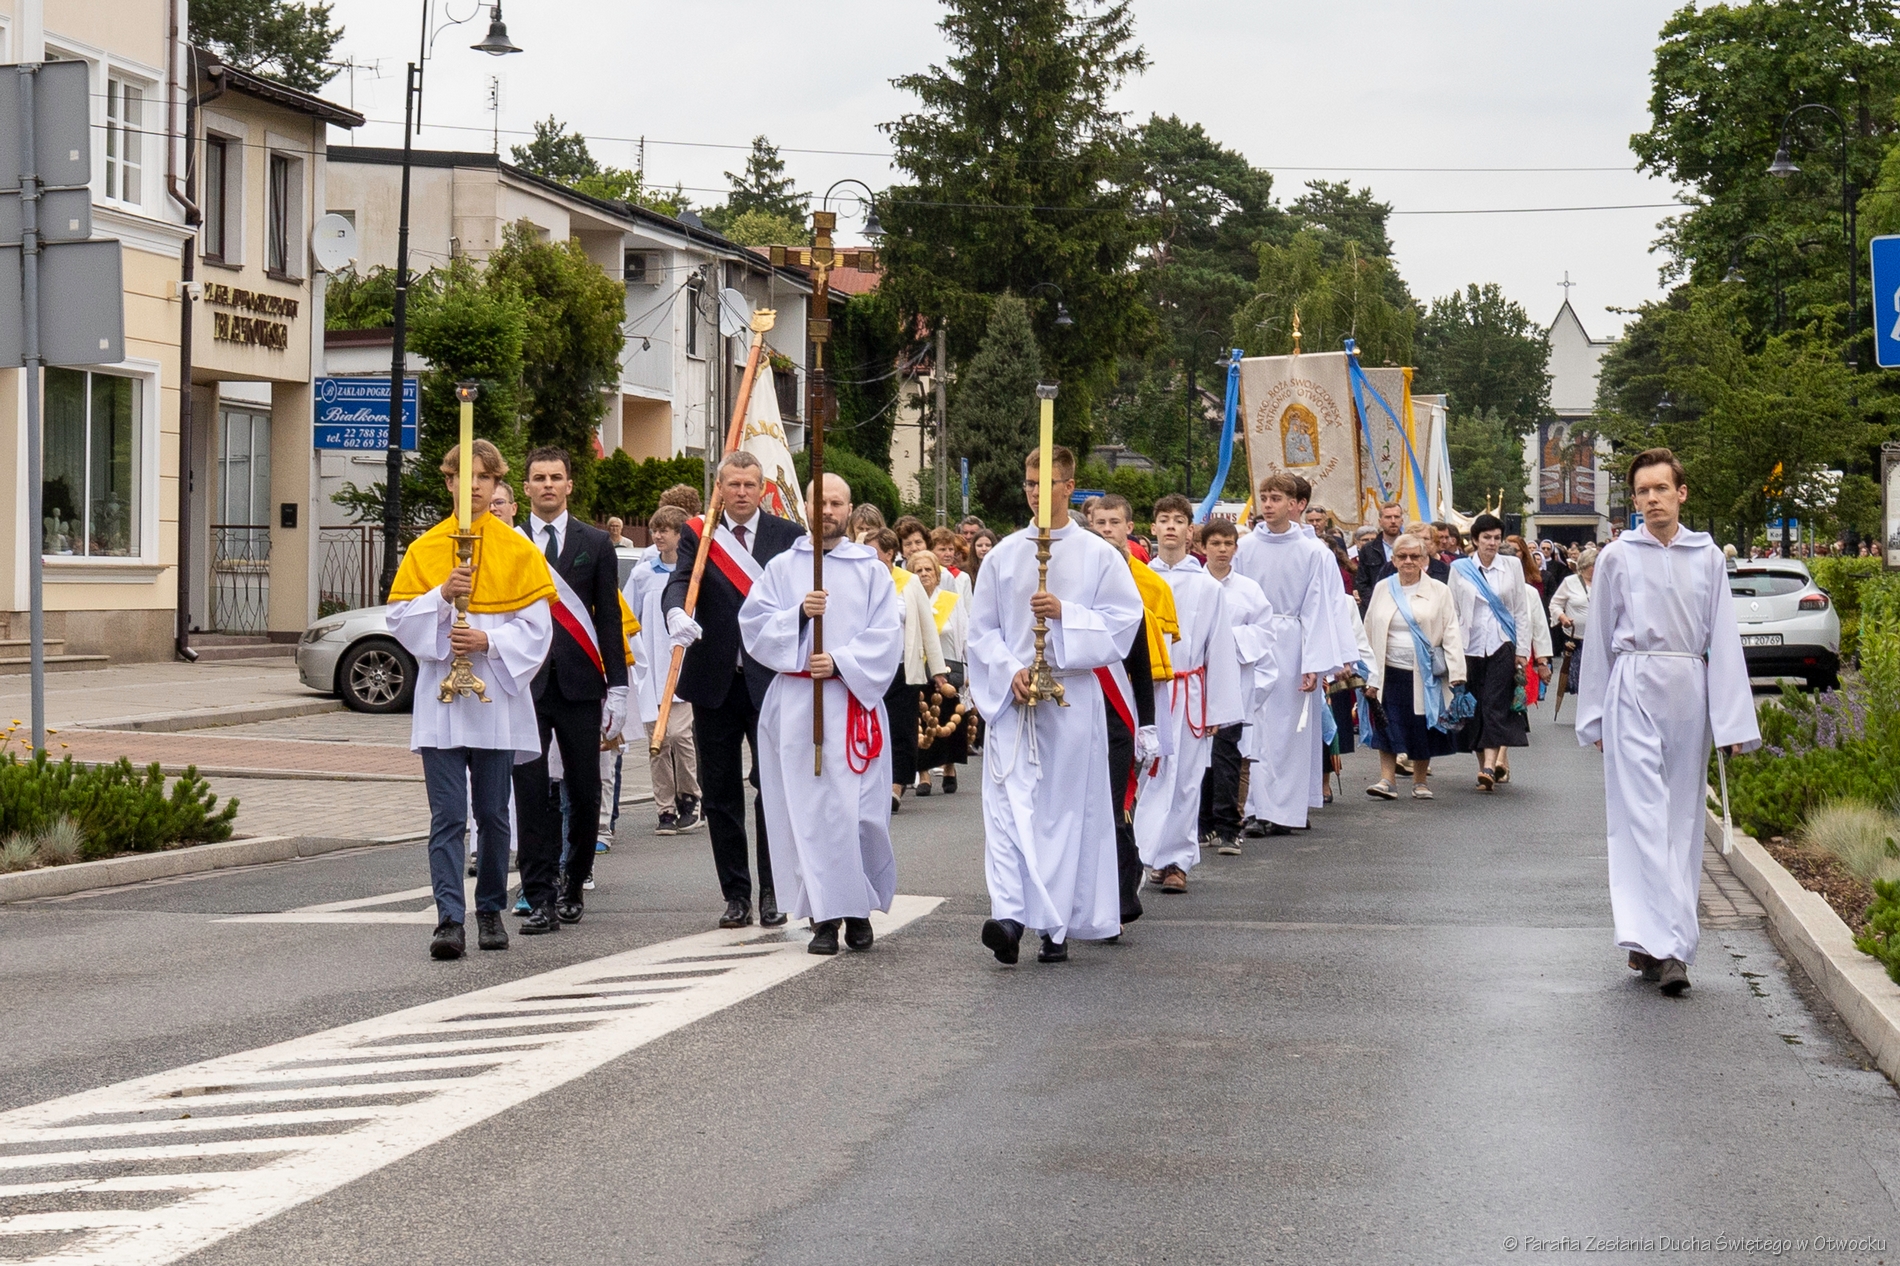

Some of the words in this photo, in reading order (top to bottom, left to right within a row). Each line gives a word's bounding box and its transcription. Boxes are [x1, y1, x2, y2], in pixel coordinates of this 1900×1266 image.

[366, 387, 415, 397] POGRZWY
[1265, 389, 1292, 431] PATRONKO
[1297, 388, 1335, 427] OTWOCKA
[1256, 400, 1269, 434] MATKO
[326, 433, 341, 443] tel.
[344, 428, 356, 438] 22
[359, 428, 375, 438] 788
[343, 438, 360, 448] 602
[362, 439, 375, 448] 69
[376, 439, 389, 448] 39
[904, 450, 910, 458] 2
[1319, 456, 1339, 480] NAMI
